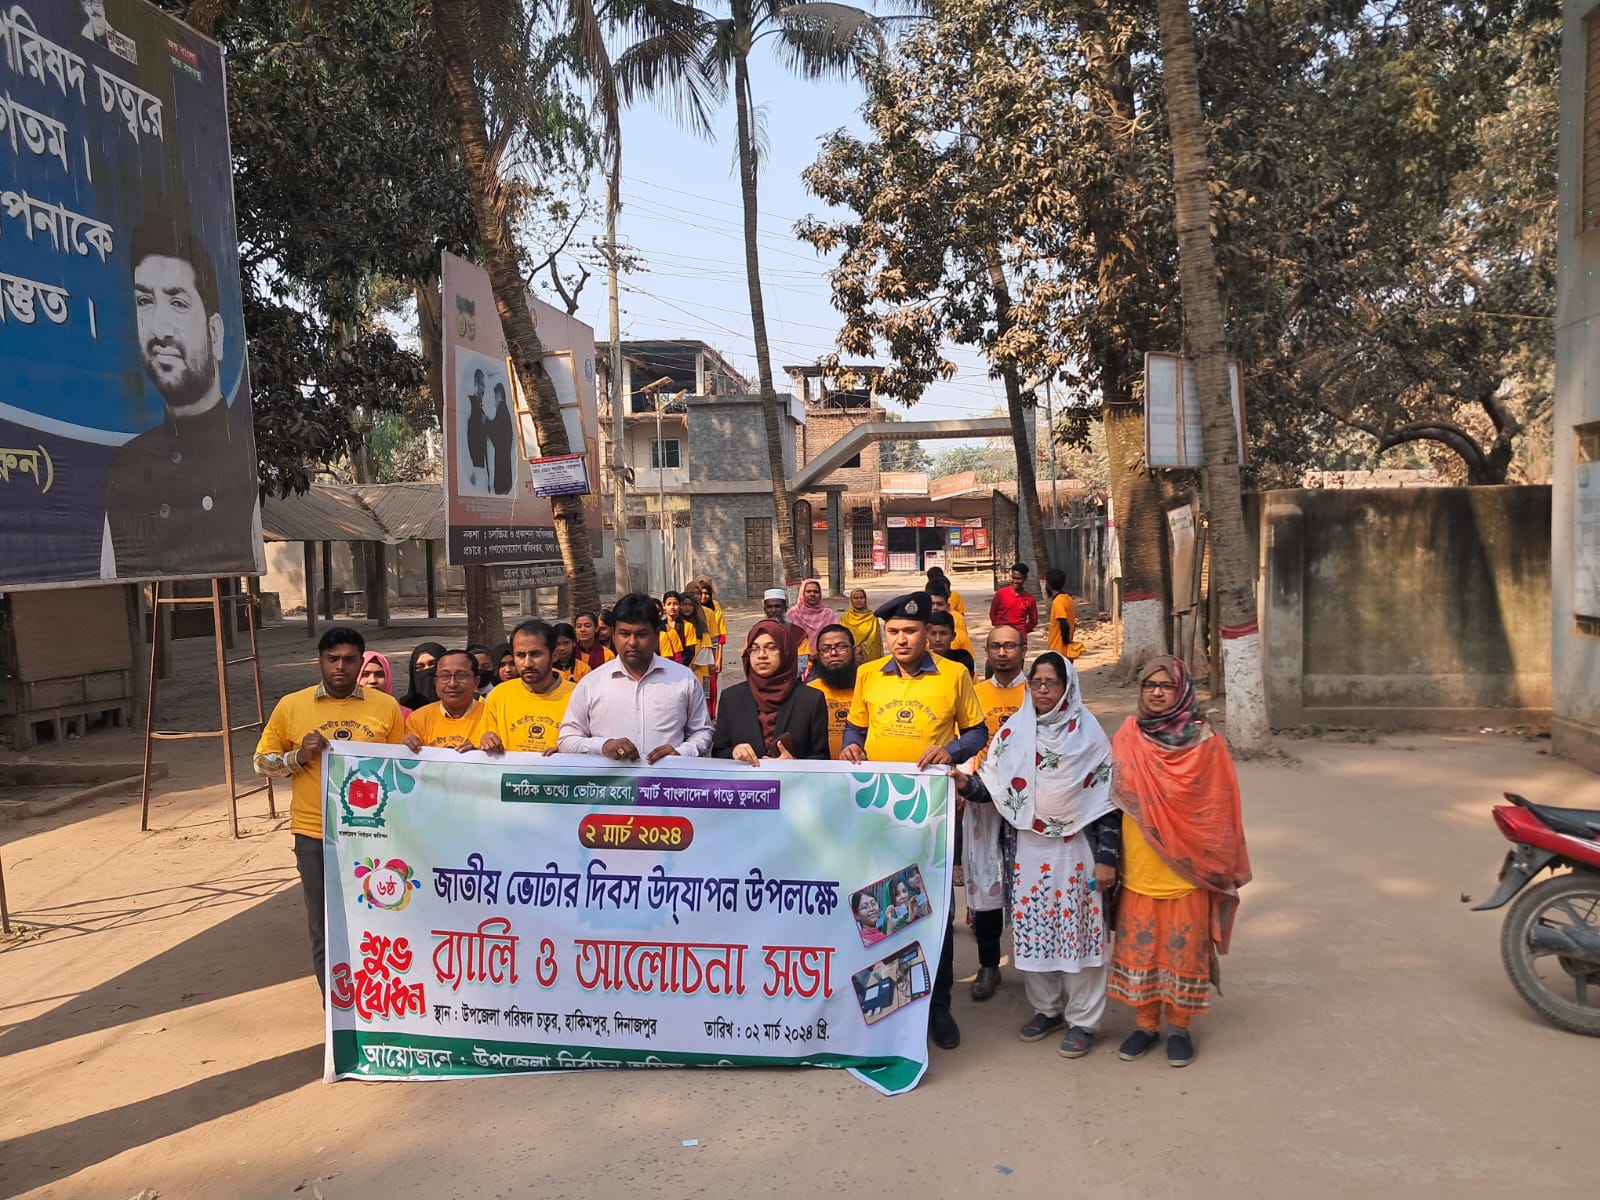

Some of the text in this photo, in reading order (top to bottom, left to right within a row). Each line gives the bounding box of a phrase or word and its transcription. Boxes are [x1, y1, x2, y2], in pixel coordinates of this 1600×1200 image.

[0, 271, 70, 323] স্তুত
[542, 784, 570, 798] তথ্যে
[573, 781, 607, 799] ভোটার
[662, 786, 711, 803] বাংলাদেশ
[713, 788, 736, 805] গড়ে
[585, 816, 682, 846] ২ মার্চ ২০২৪
[377, 876, 397, 897] ৬ষ্ঠ
[432, 852, 501, 905] জাতীয়
[506, 861, 582, 908] ভোটার
[585, 858, 642, 911] দিবস
[745, 867, 840, 916] উপলক্ষে
[359, 930, 414, 983] শুভ
[535, 937, 558, 988] ও
[573, 938, 749, 997] আলোচনা
[762, 945, 836, 1000] সভা
[433, 1003, 451, 1026] স্থান
[461, 1001, 500, 1026] উপজেলা
[503, 1005, 534, 1029] পরিষদ
[613, 1011, 658, 1040] দিনাজপুর
[703, 1016, 735, 1041] তারিখ
[745, 1023, 760, 1044] ০২
[763, 1017, 783, 1043] মার্চ
[784, 1024, 813, 1044] ২০২৪
[361, 1042, 452, 1069] আয়োজনে
